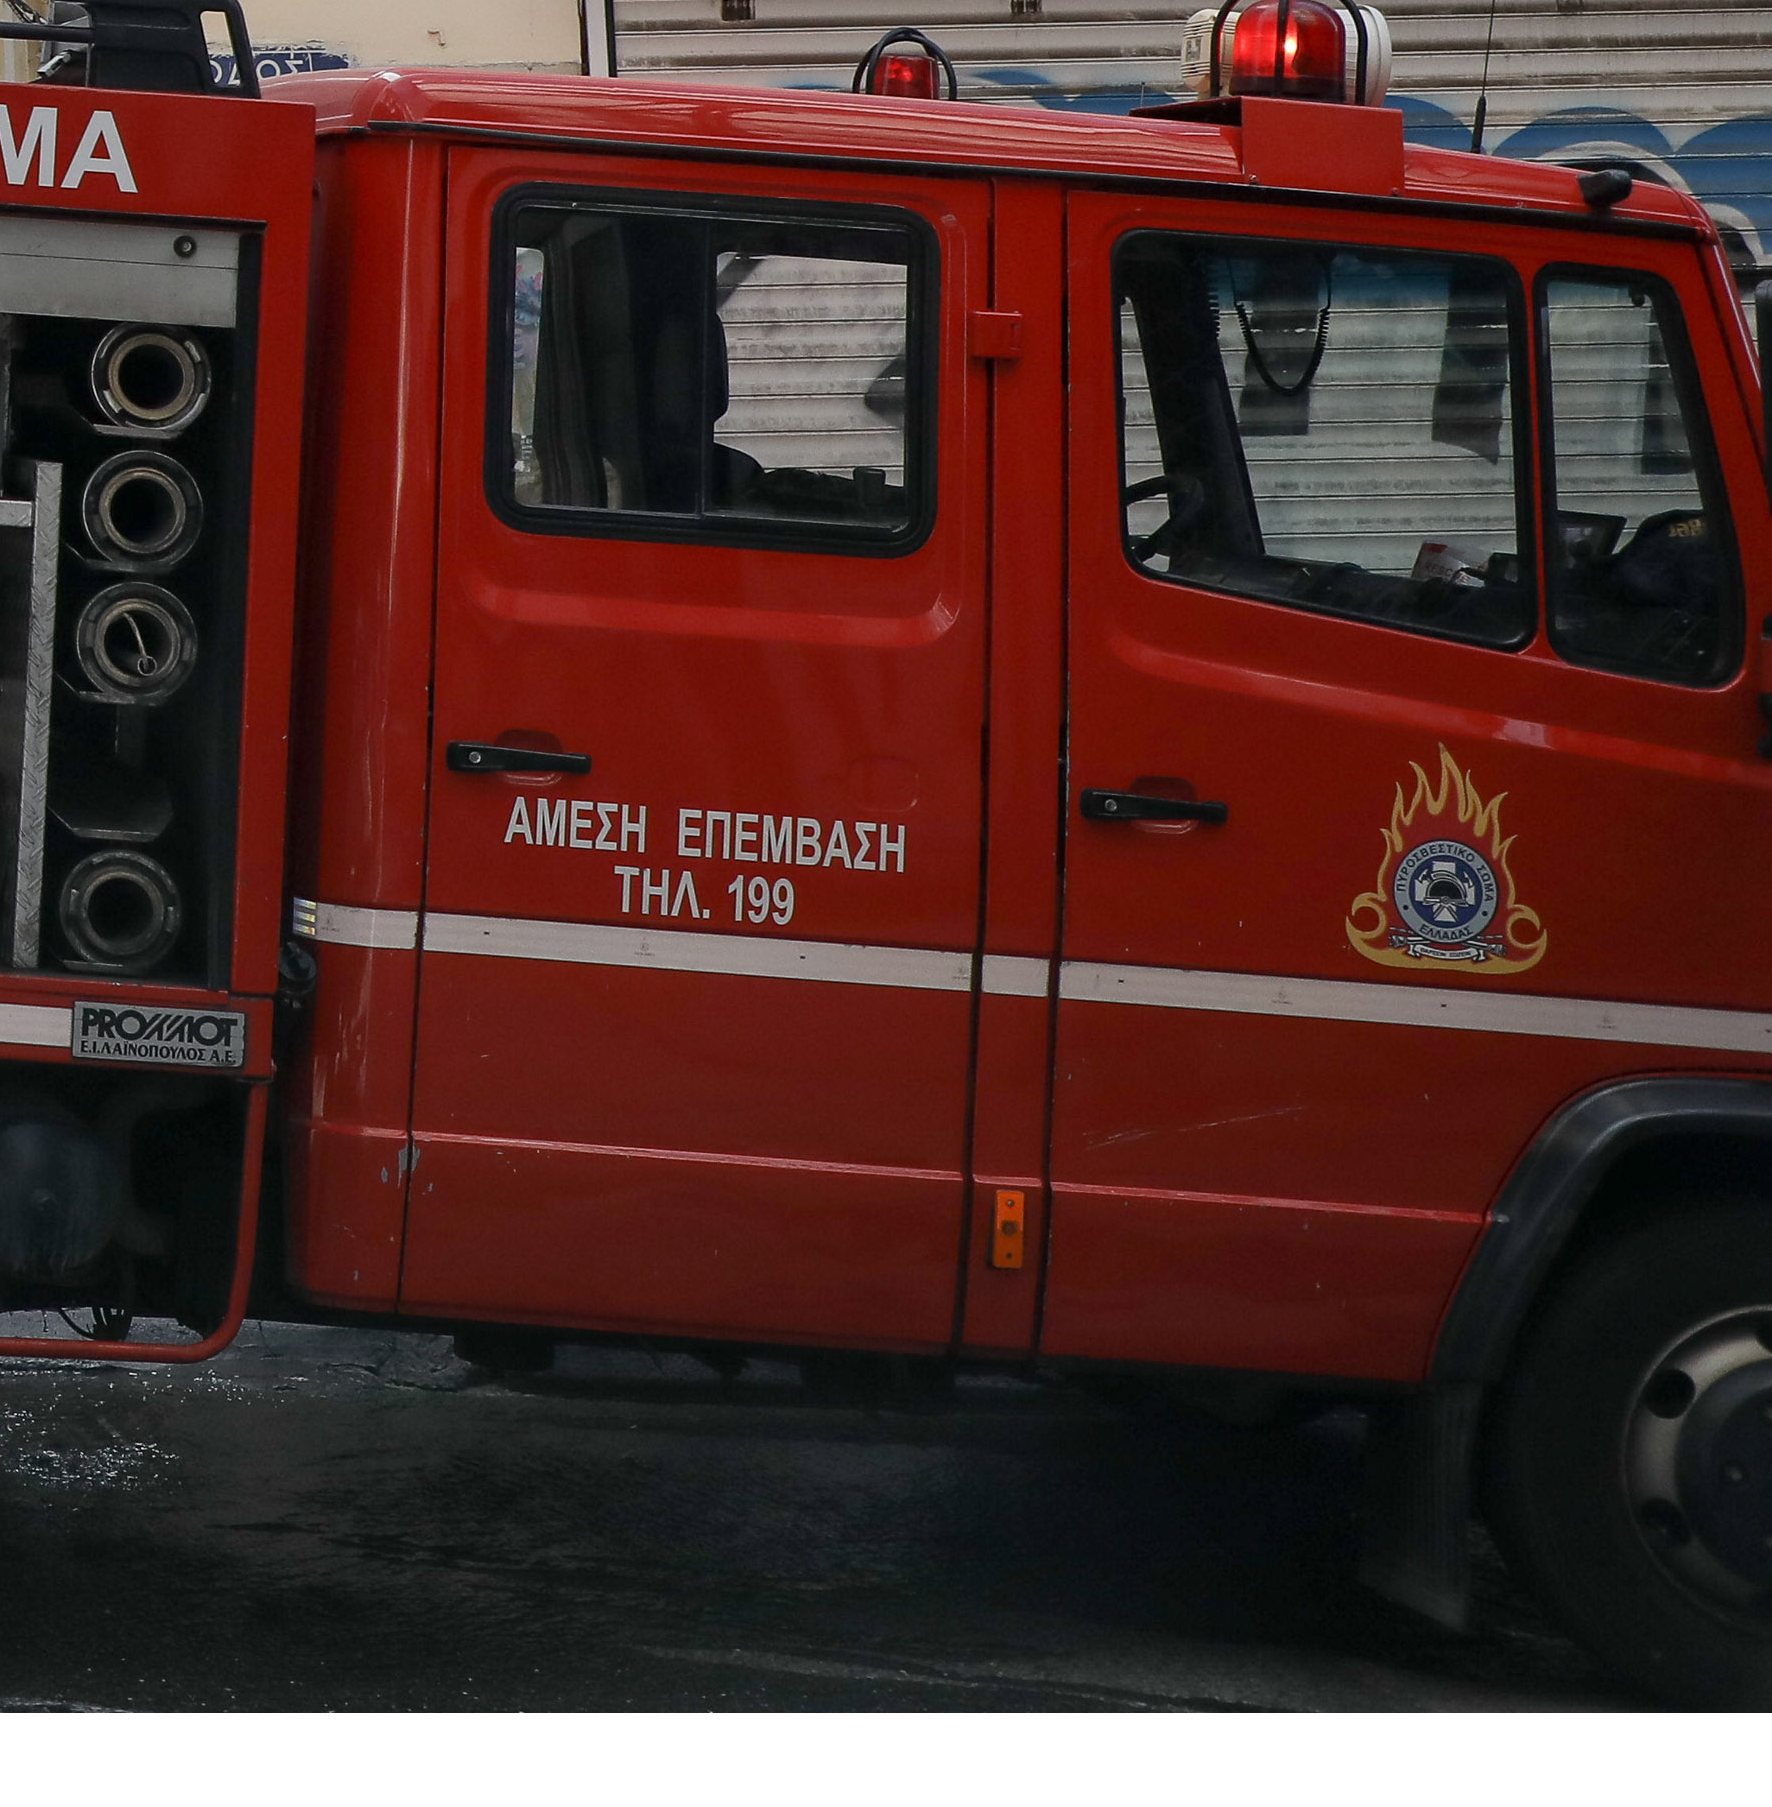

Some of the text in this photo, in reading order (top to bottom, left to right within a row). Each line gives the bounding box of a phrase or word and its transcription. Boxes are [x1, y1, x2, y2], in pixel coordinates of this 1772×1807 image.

[503, 796, 906, 873] ΑΜΕΣΗ ΕΠΕΜΒΑΣΗ
[614, 866, 795, 925] ΤΗΛ. 199
[1396, 843, 1495, 902] ΠΥΡΟΣΒΕΣΤΙΚΟ ΣΩΜΑ
[1419, 923, 1474, 941] ΕΛΛΑΔΑΣ
